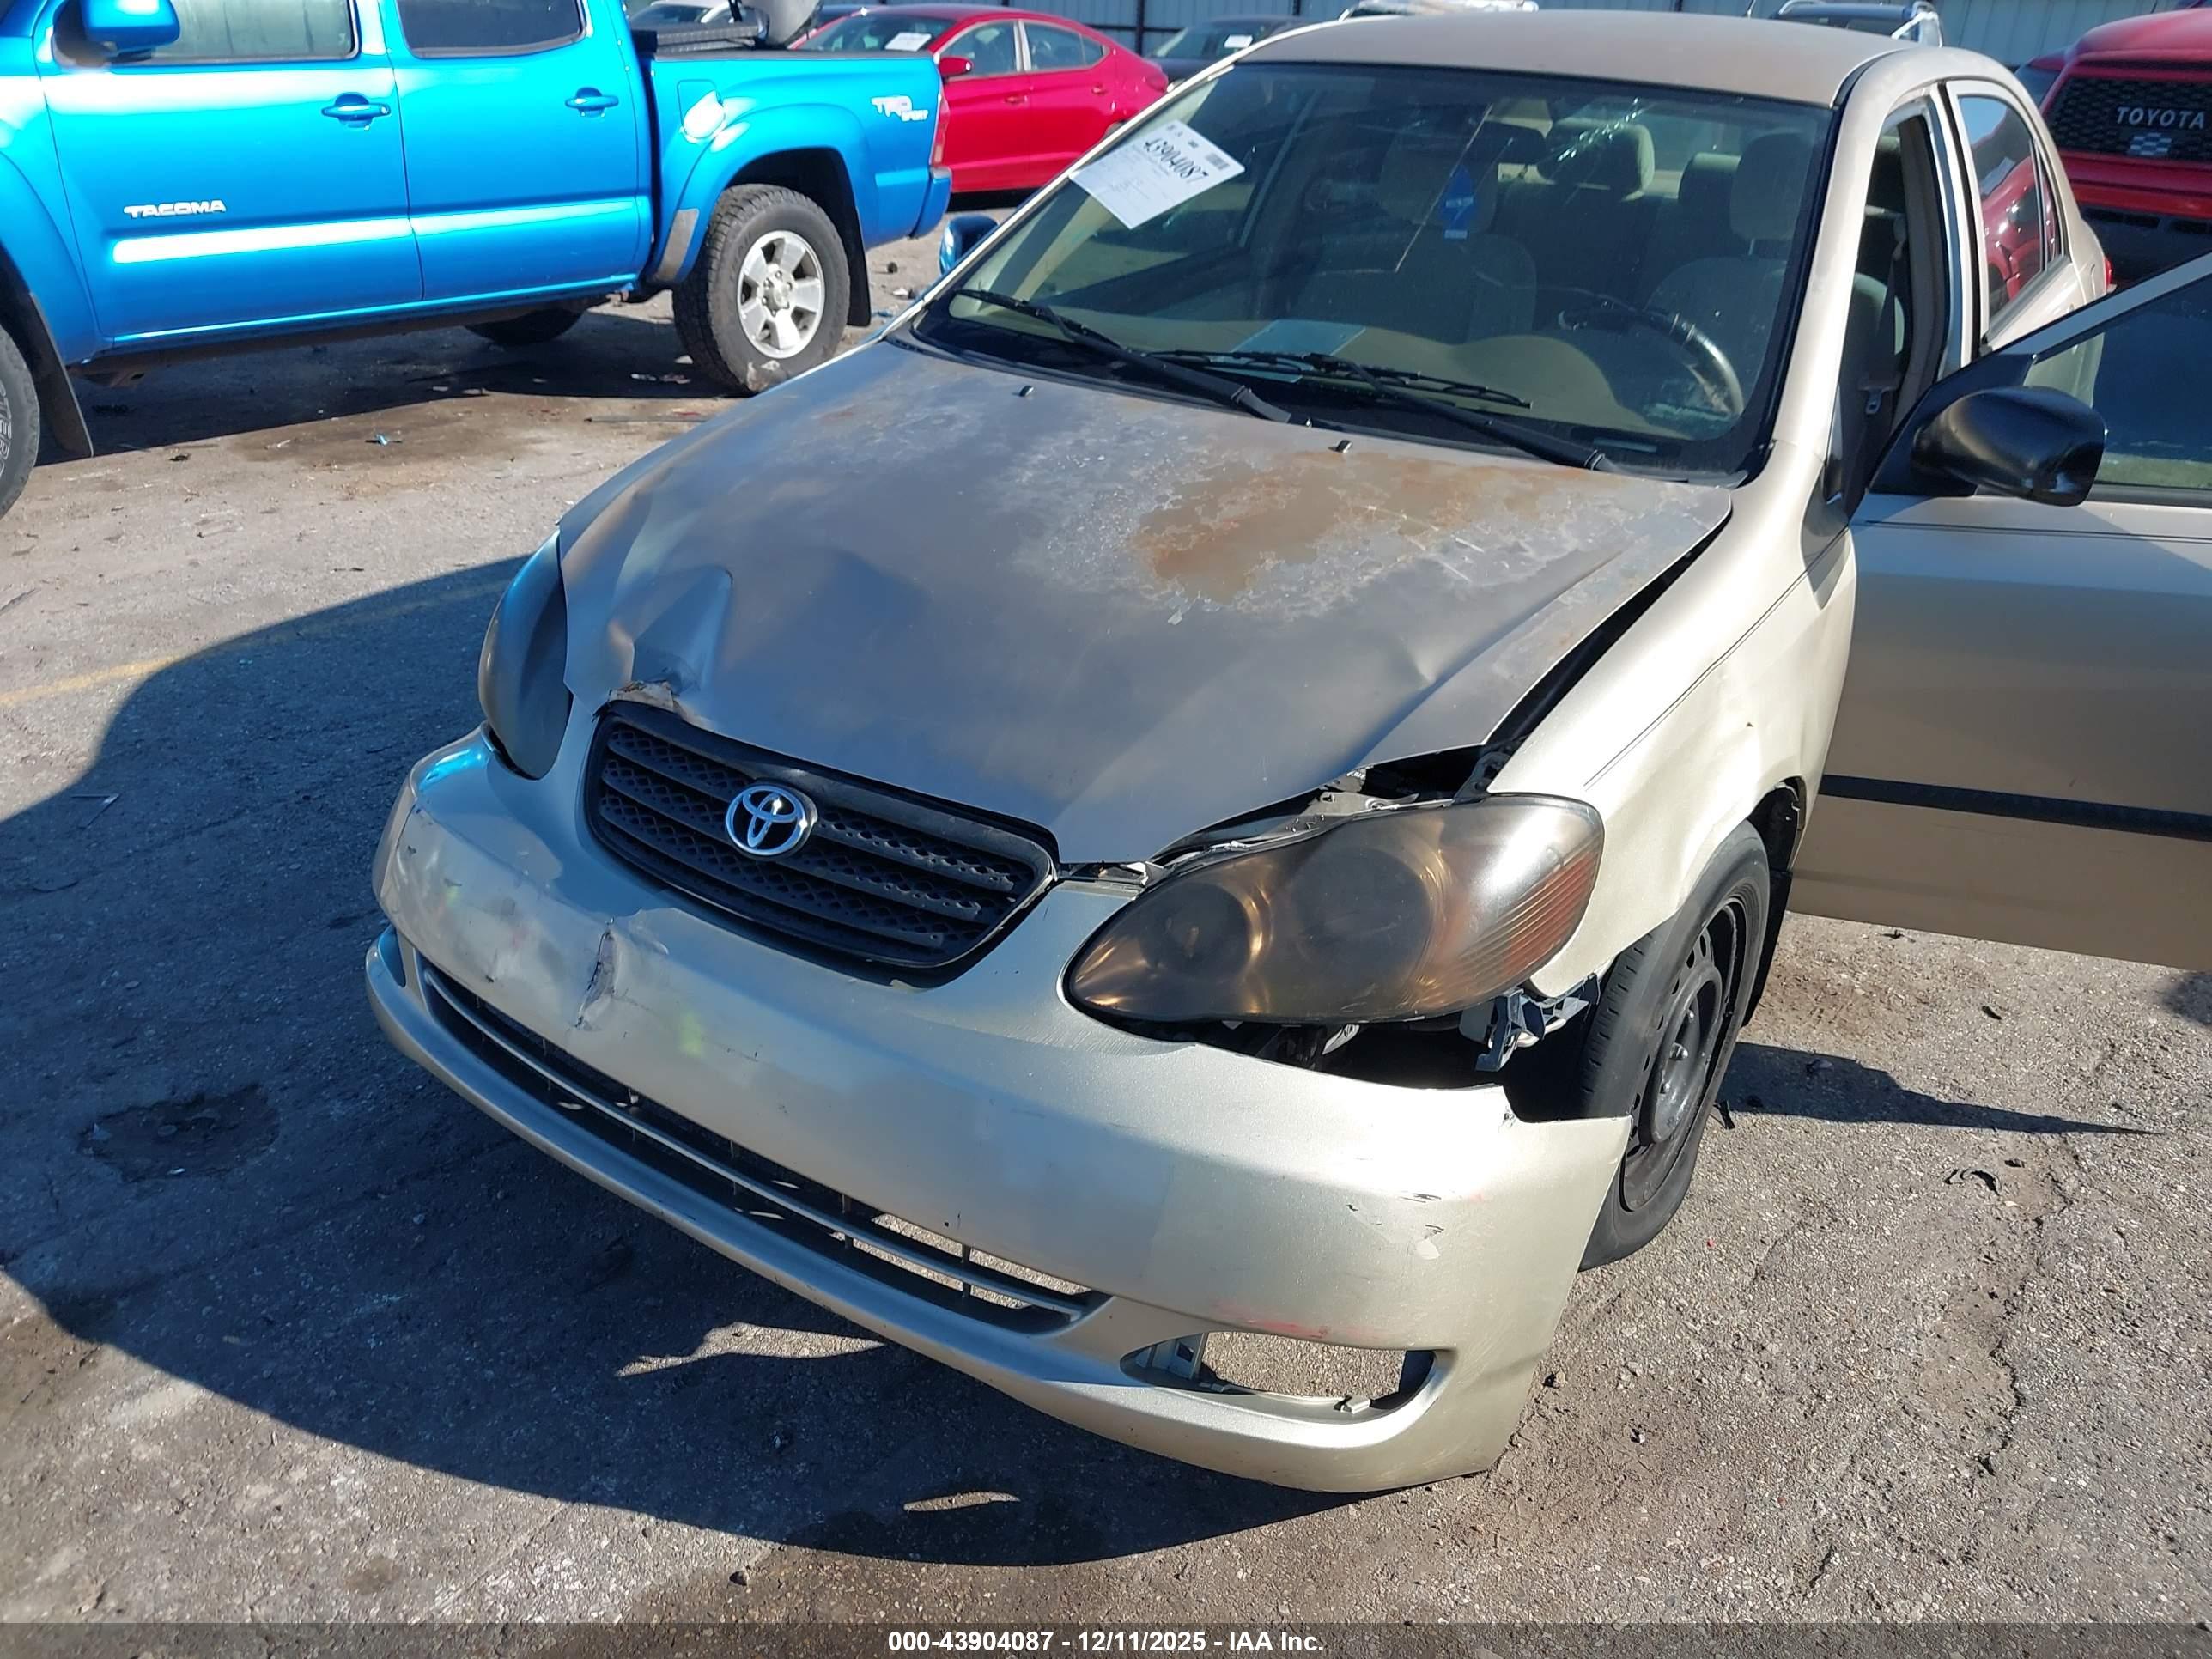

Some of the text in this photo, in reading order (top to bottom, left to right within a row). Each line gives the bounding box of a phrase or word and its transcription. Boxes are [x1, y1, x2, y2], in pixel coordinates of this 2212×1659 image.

[871, 95, 912, 118] TRD
[2116, 106, 2205, 129] TOYOTA
[1144, 137, 1209, 185] 43904087
[123, 199, 227, 219] TACOMA
